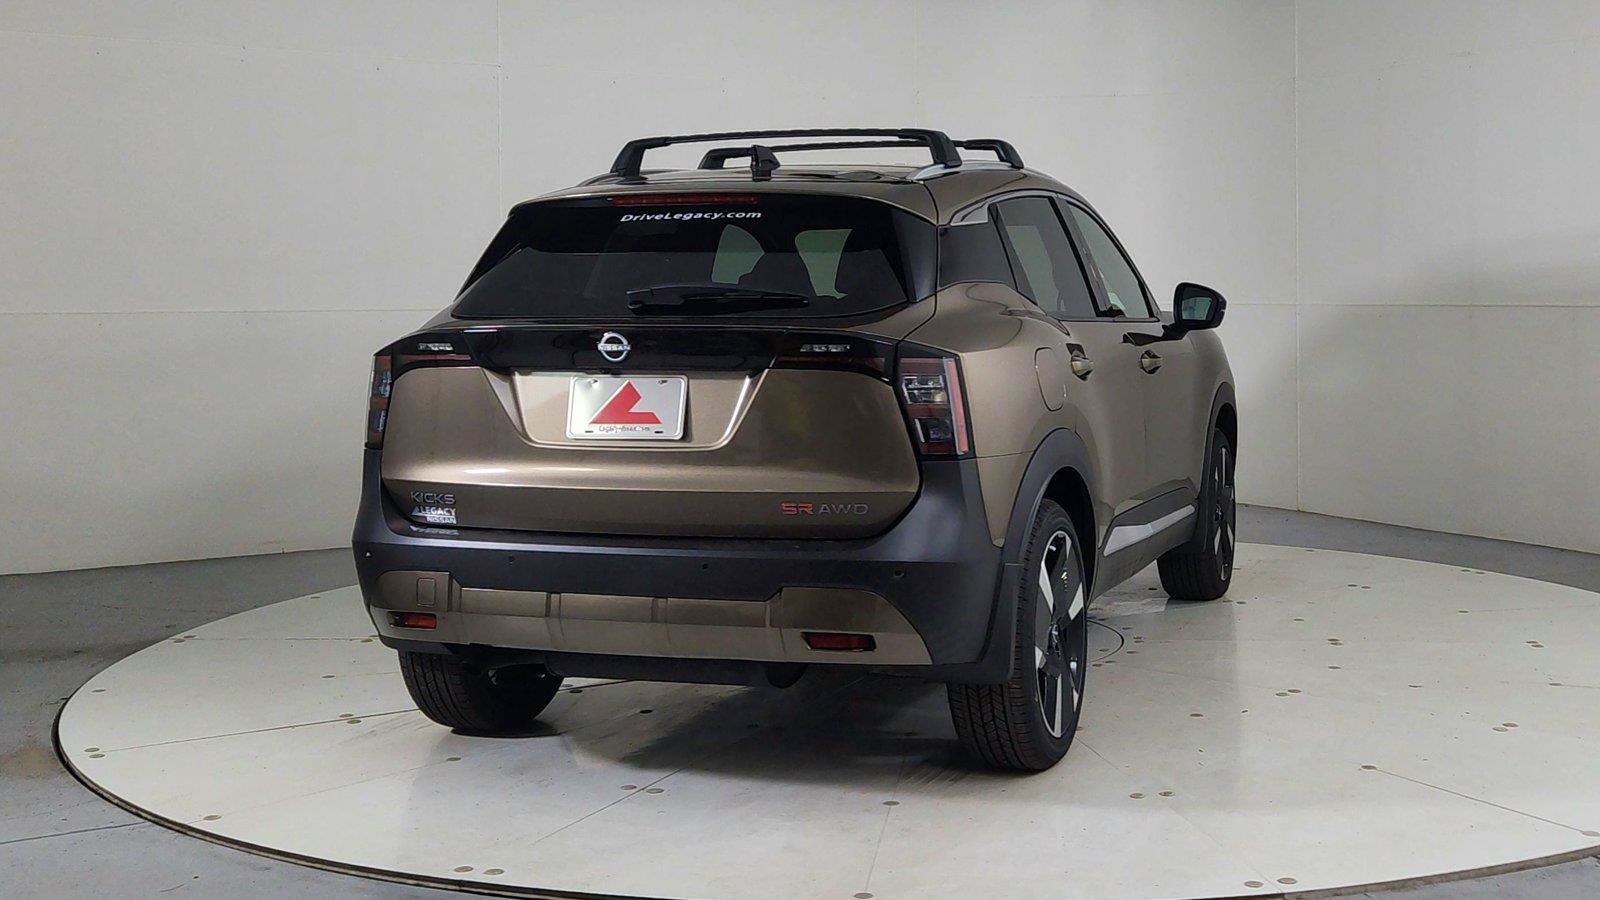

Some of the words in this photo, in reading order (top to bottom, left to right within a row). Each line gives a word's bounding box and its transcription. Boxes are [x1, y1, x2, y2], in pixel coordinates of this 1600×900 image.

[620, 211, 762, 222] DriveLegacy.com
[598, 343, 631, 351] NISSAN
[410, 491, 456, 504] KICKS
[420, 506, 456, 516] LEGACY
[780, 501, 814, 515] SR
[819, 503, 869, 515] AWD
[426, 516, 457, 524] NISSAN
